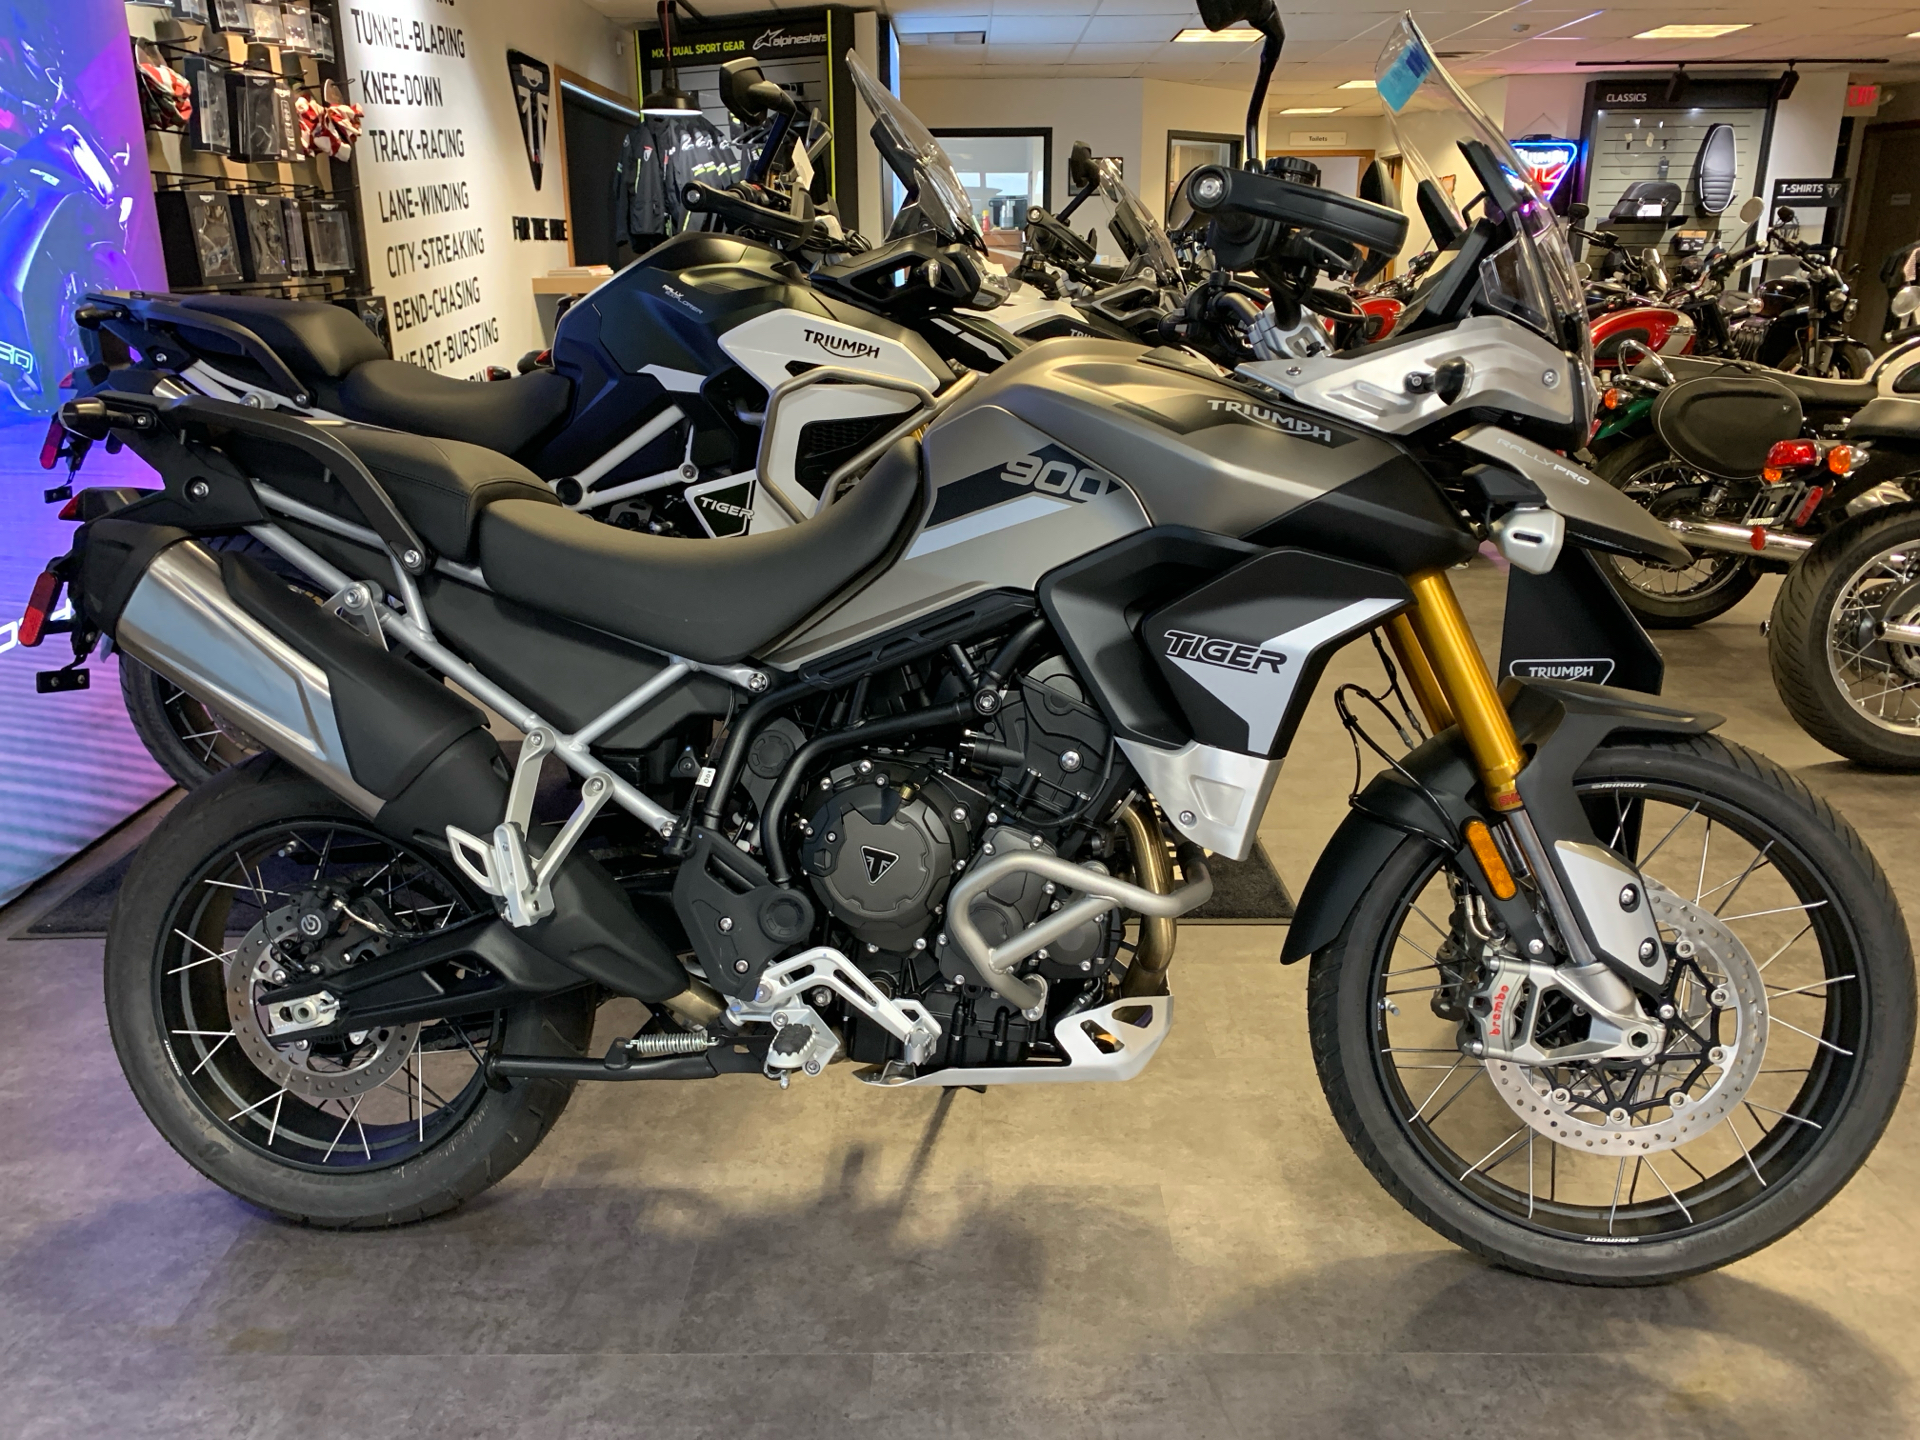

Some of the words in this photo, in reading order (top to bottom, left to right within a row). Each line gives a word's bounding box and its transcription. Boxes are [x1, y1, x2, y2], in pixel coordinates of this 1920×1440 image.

[351, 8, 465, 58] TUNNEL-BLARING
[652, 49, 665, 58] MX
[673, 46, 694, 56] DUAL
[696, 43, 721, 54] SPORT
[723, 41, 745, 51] GEAR
[773, 33, 828, 47] alpinestars
[360, 70, 443, 107] KNEE-DOWN
[1606, 93, 1647, 103] CLASSICS
[369, 129, 465, 162] TRACK-RACING
[378, 181, 470, 223] LANE-WINDING
[1781, 183, 1824, 194] T-SHIRTS
[386, 227, 485, 278] CITY-STREAKING
[393, 276, 481, 332] BEND-CHASING
[400, 317, 499, 370] EART-BURSTING
[804, 328, 880, 359] TRIUMPH
[1207, 399, 1332, 442] TRIUMPH
[1001, 455, 1109, 501] 900
[700, 496, 755, 521] TIGER
[1163, 629, 1288, 674] TIGER
[1528, 666, 1594, 681] TRIUMPH
[1489, 985, 1509, 1036] brembo
